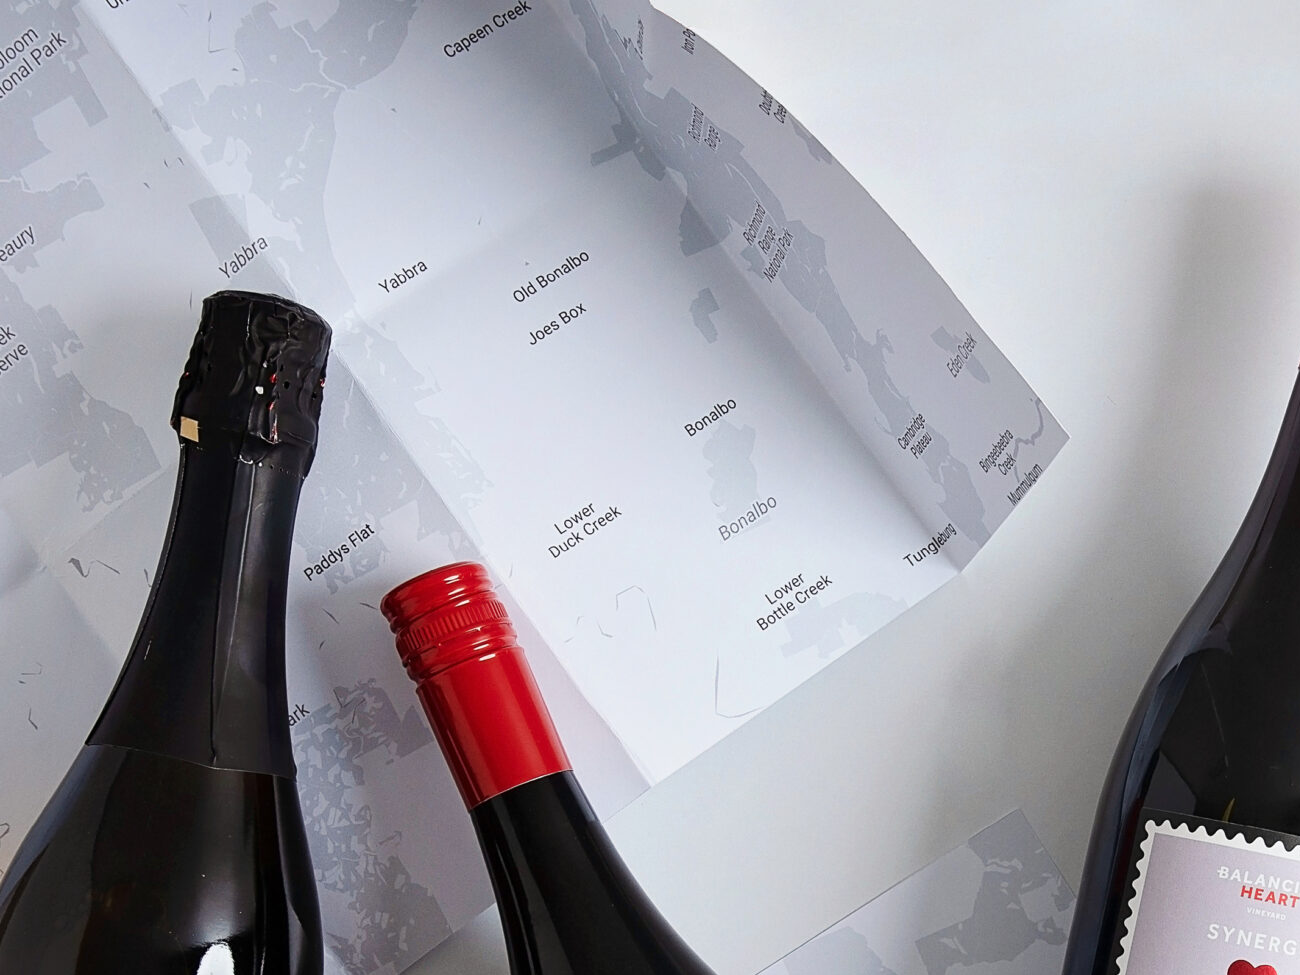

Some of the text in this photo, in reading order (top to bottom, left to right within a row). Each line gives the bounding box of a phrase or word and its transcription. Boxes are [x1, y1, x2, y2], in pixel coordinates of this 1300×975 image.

[443, 0, 532, 58] Capeen Creek
[0, 32, 68, 98] ional Park
[704, 126, 721, 150] Range
[742, 200, 766, 246] Richmond
[757, 225, 776, 255] Range
[218, 236, 268, 280] Yabbra
[762, 226, 794, 282] National Park
[378, 259, 428, 294] Yabbra
[512, 250, 590, 303] Old Bonalbo
[528, 302, 588, 346] Joes Box
[0, 342, 28, 376] erve
[946, 332, 978, 378] Eden Creek
[684, 398, 737, 438] Bonalbo
[897, 412, 926, 450] Cambridge
[910, 430, 932, 460] Plateau
[997, 452, 1017, 476] Creek
[548, 504, 623, 560] Duck Creek
[554, 502, 596, 536] Lower
[718, 494, 778, 542] Bonalbo
[302, 522, 376, 582] Paddys Flat
[902, 522, 957, 566] Tunglebung
[756, 574, 834, 632] Bottle Creek
[764, 572, 806, 606] Lower
[1240, 885, 1300, 909] HEART
[1246, 906, 1287, 921] VINEYARD
